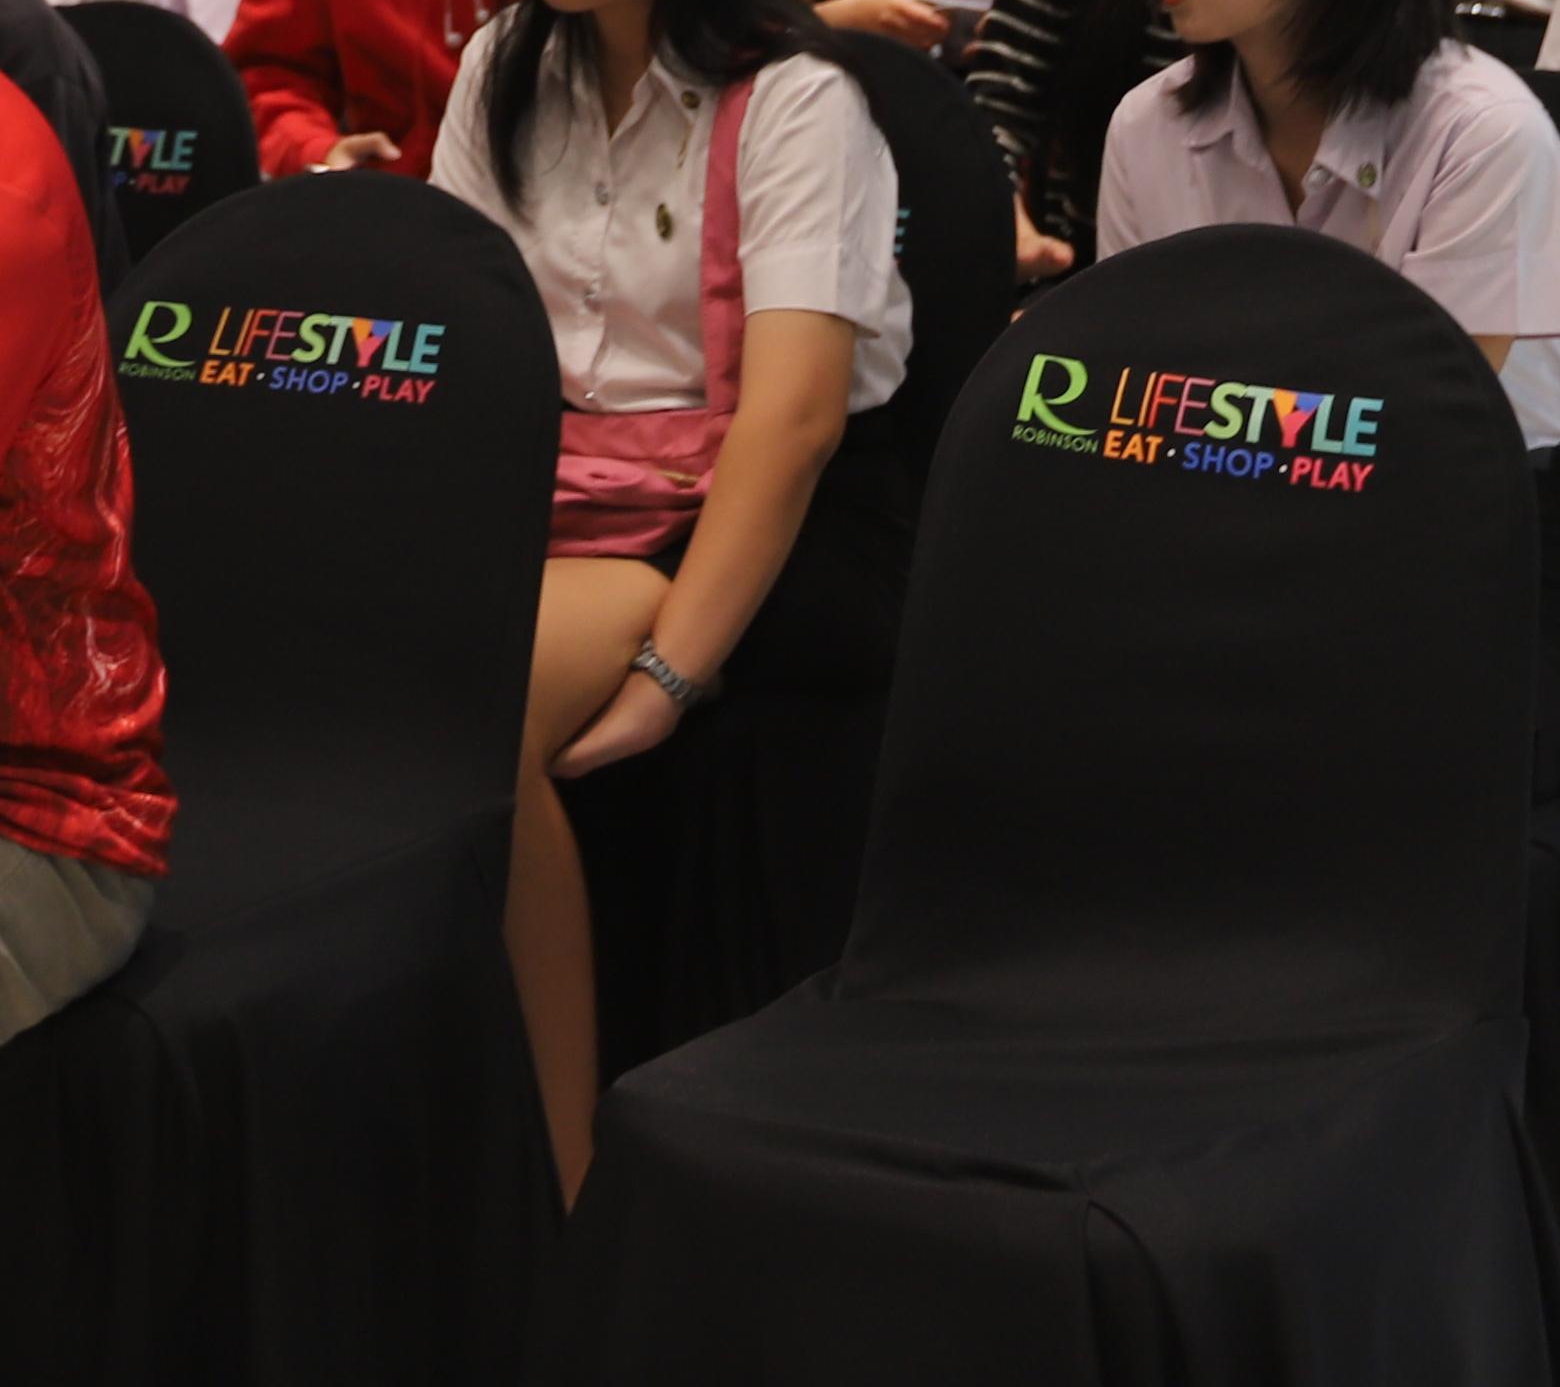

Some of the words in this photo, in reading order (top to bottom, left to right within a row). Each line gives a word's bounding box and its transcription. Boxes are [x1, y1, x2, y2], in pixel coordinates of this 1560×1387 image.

[108, 126, 198, 170] TYLE
[208, 306, 446, 375] LIFESTYLE
[118, 362, 197, 382] ROBINSON
[1109, 366, 1384, 457] LIFESTYLE
[1011, 425, 1099, 455] ROBINSON
